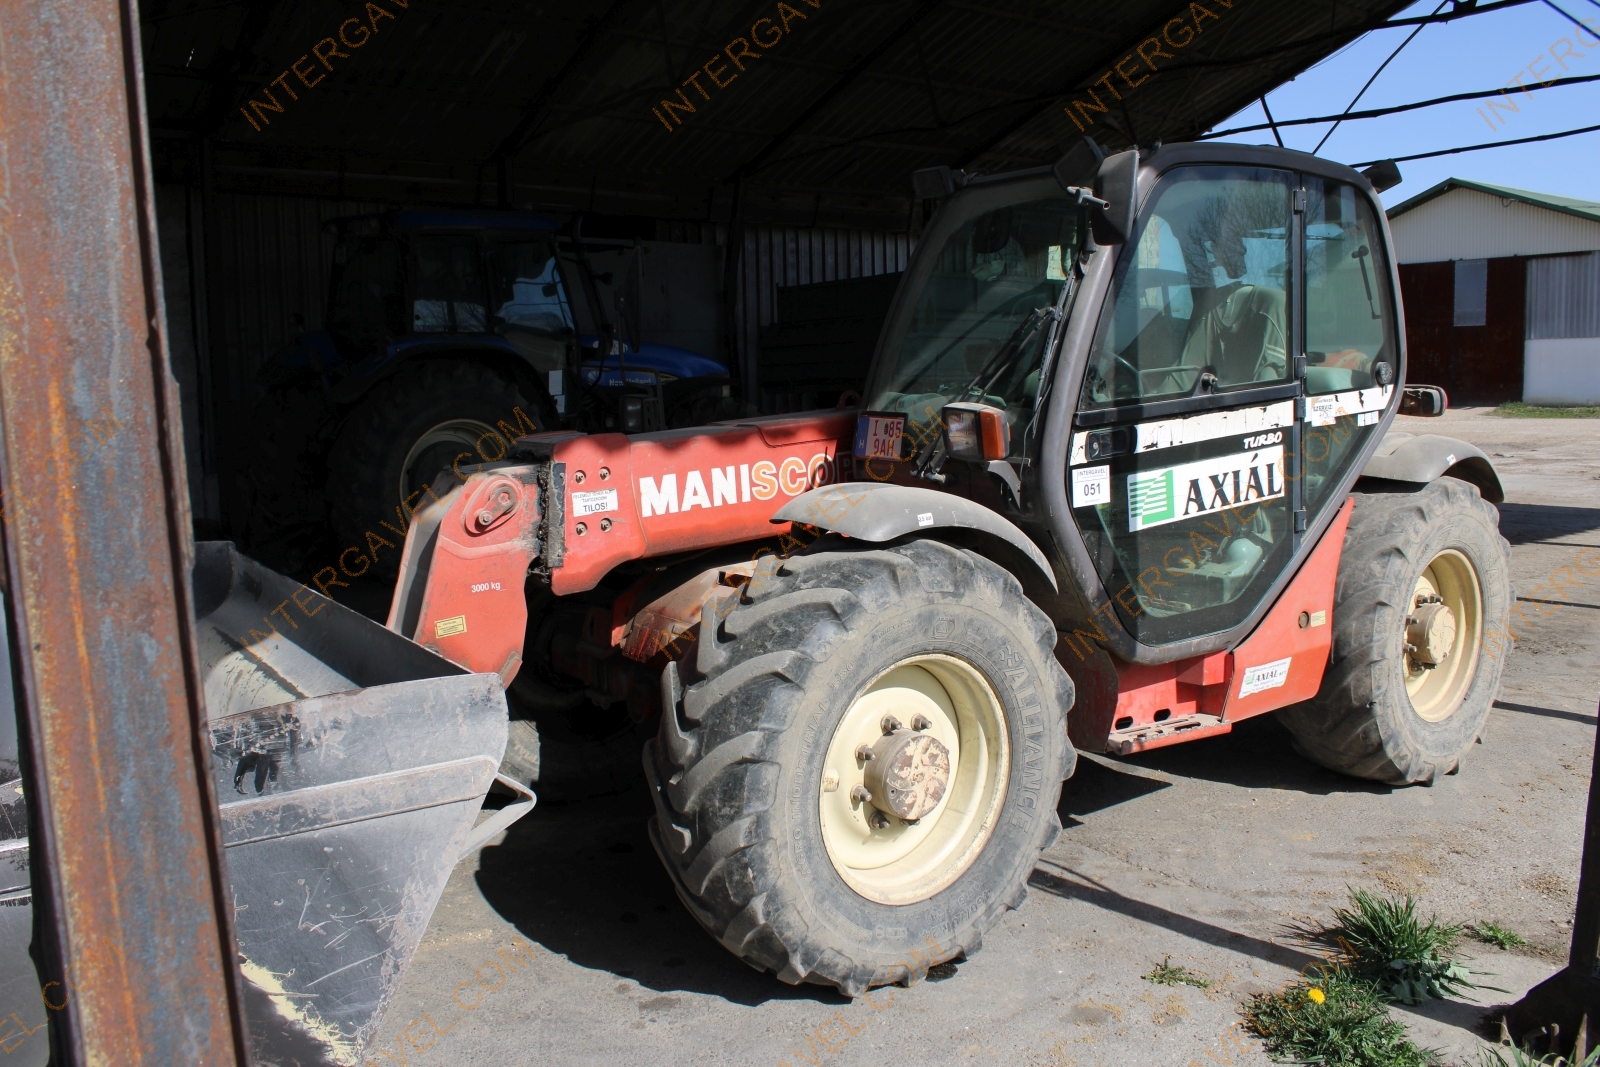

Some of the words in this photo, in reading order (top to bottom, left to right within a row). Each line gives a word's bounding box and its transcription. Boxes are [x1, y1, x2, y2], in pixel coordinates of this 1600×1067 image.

[1243, 431, 1282, 449] TURBO
[1083, 482, 1101, 497] 051
[1182, 453, 1284, 516] AXIÁL
[583, 502, 608, 513] TILOS!
[471, 582, 490, 593] 3000
[490, 581, 501, 591] kg
[1255, 668, 1278, 682] AXIÁL
[1004, 662, 1045, 834] ALLIANCE
